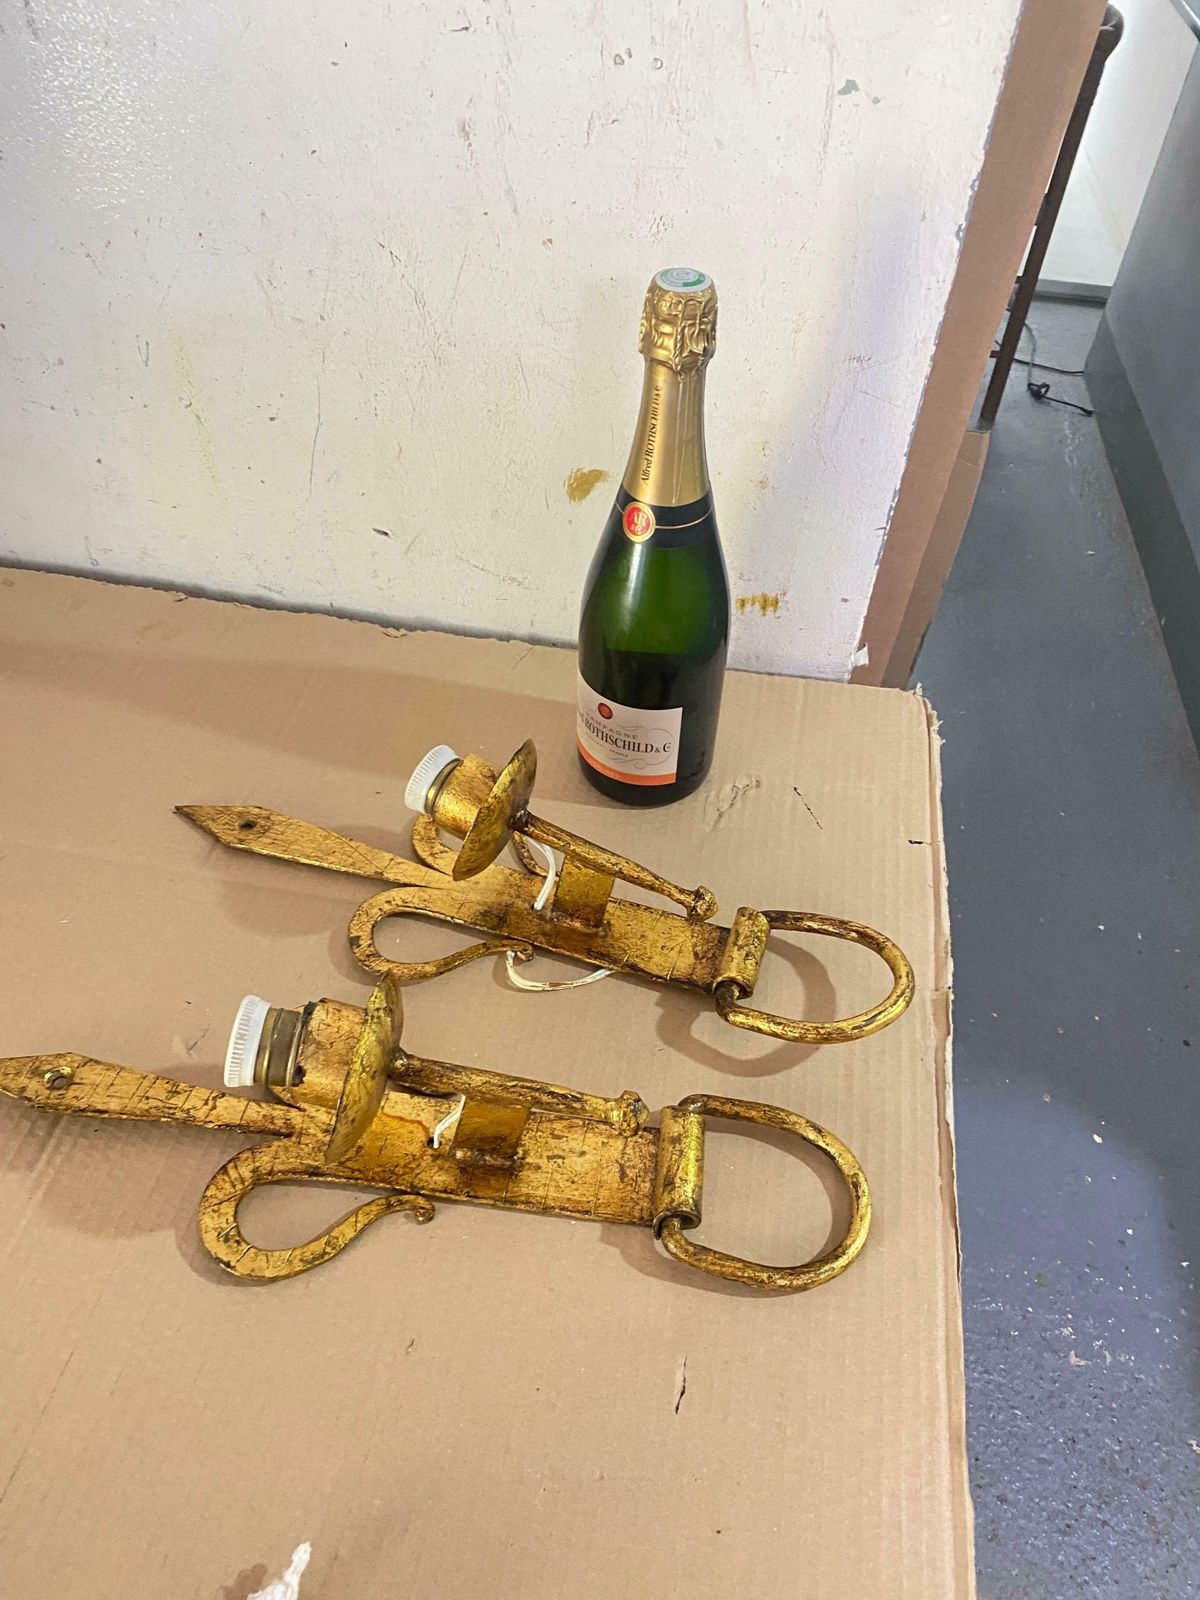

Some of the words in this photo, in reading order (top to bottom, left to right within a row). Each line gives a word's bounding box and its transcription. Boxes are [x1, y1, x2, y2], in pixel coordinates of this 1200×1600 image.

[641, 457, 652, 484] Alfred
[585, 711, 638, 739] AMPAGNE
[585, 718, 654, 753] ROTHSCHILD
